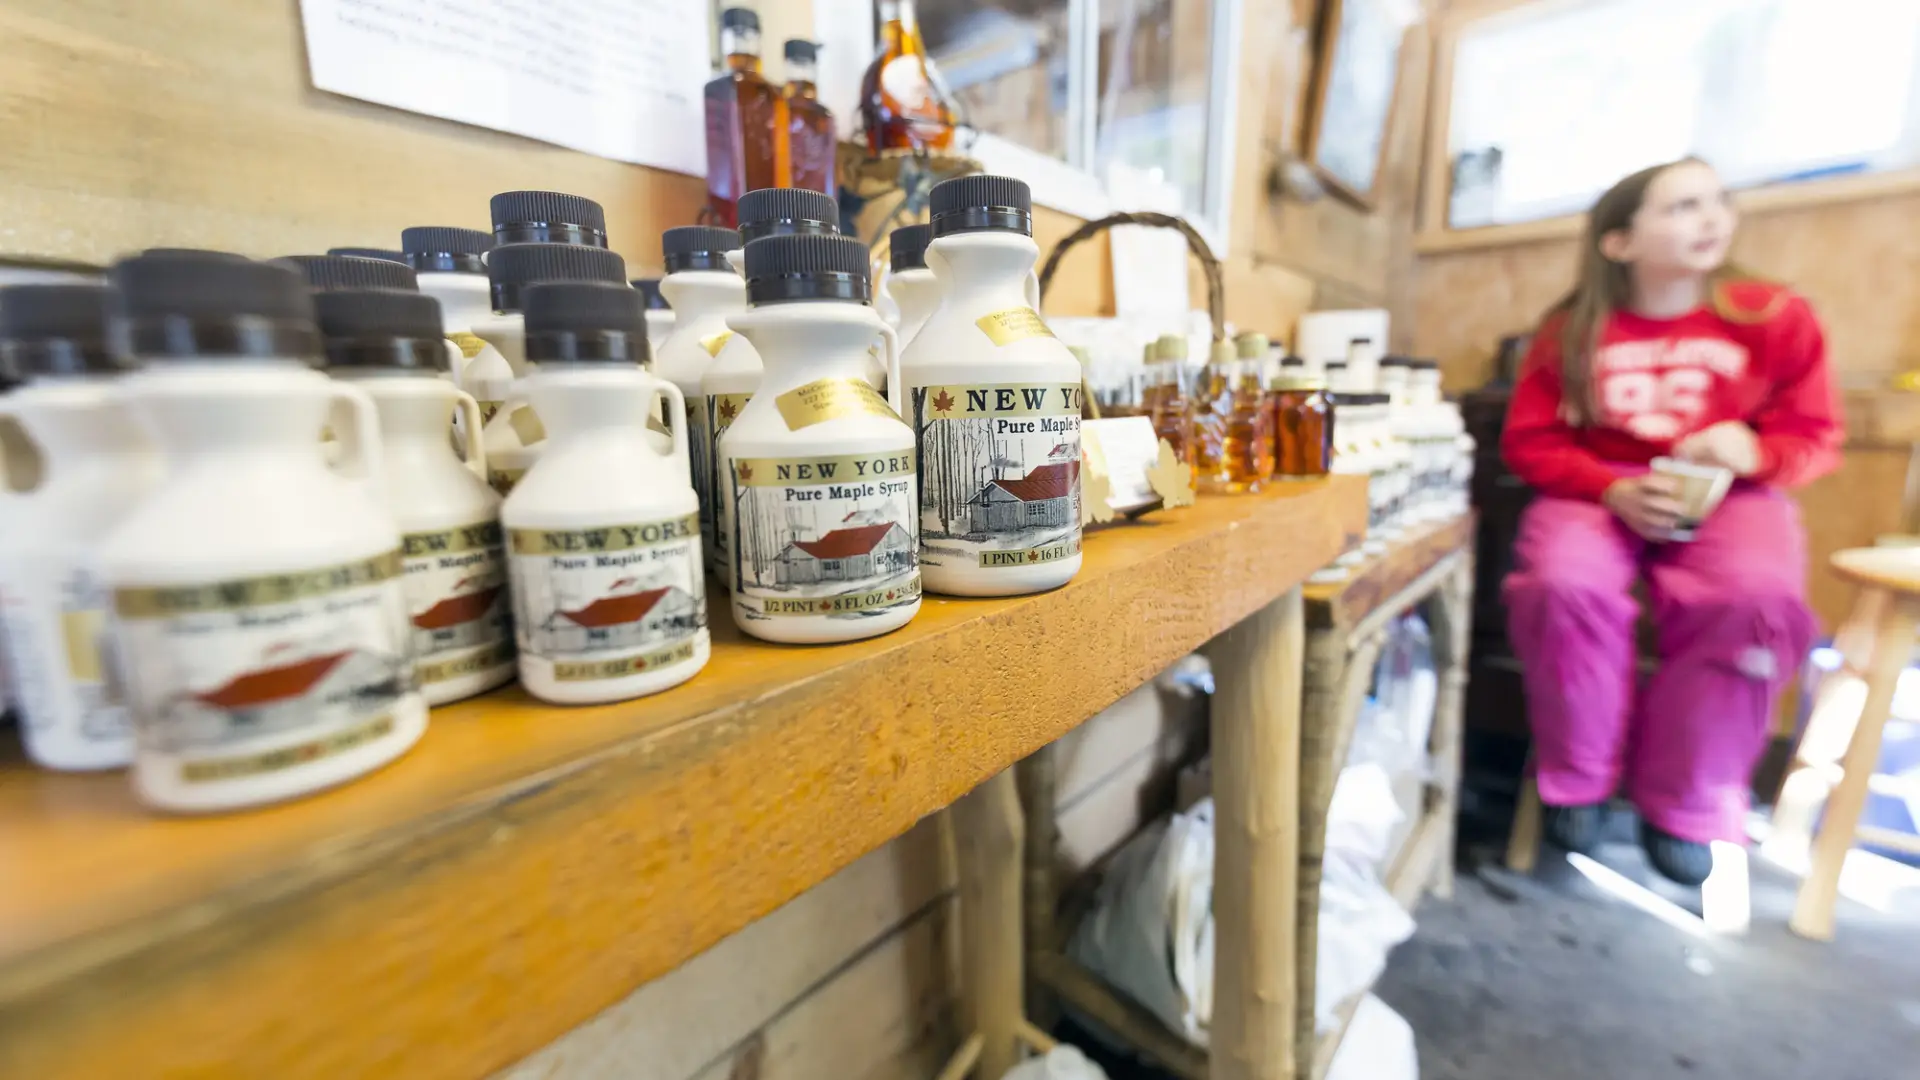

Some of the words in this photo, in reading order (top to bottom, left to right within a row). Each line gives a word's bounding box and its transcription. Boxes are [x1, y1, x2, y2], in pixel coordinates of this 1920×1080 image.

[966, 388, 1047, 411] NEW
[997, 419, 1035, 434] Pure
[1040, 417, 1073, 435] Maple
[776, 462, 838, 481] NEW
[853, 456, 910, 477] YORK
[785, 487, 823, 501] Pure
[828, 484, 875, 502] Maple
[879, 480, 909, 496] Syrup
[543, 527, 611, 552] NEW
[619, 517, 691, 547] YORK
[983, 553, 988, 565] 1
[992, 551, 1025, 565] PINT
[1040, 549, 1052, 561] 16
[1054, 547, 1066, 559] FL
[764, 600, 780, 612] 1/2
[783, 601, 814, 612] PINT
[834, 602, 841, 610] 8
[845, 597, 863, 609] FL
[865, 592, 884, 605] OZ
